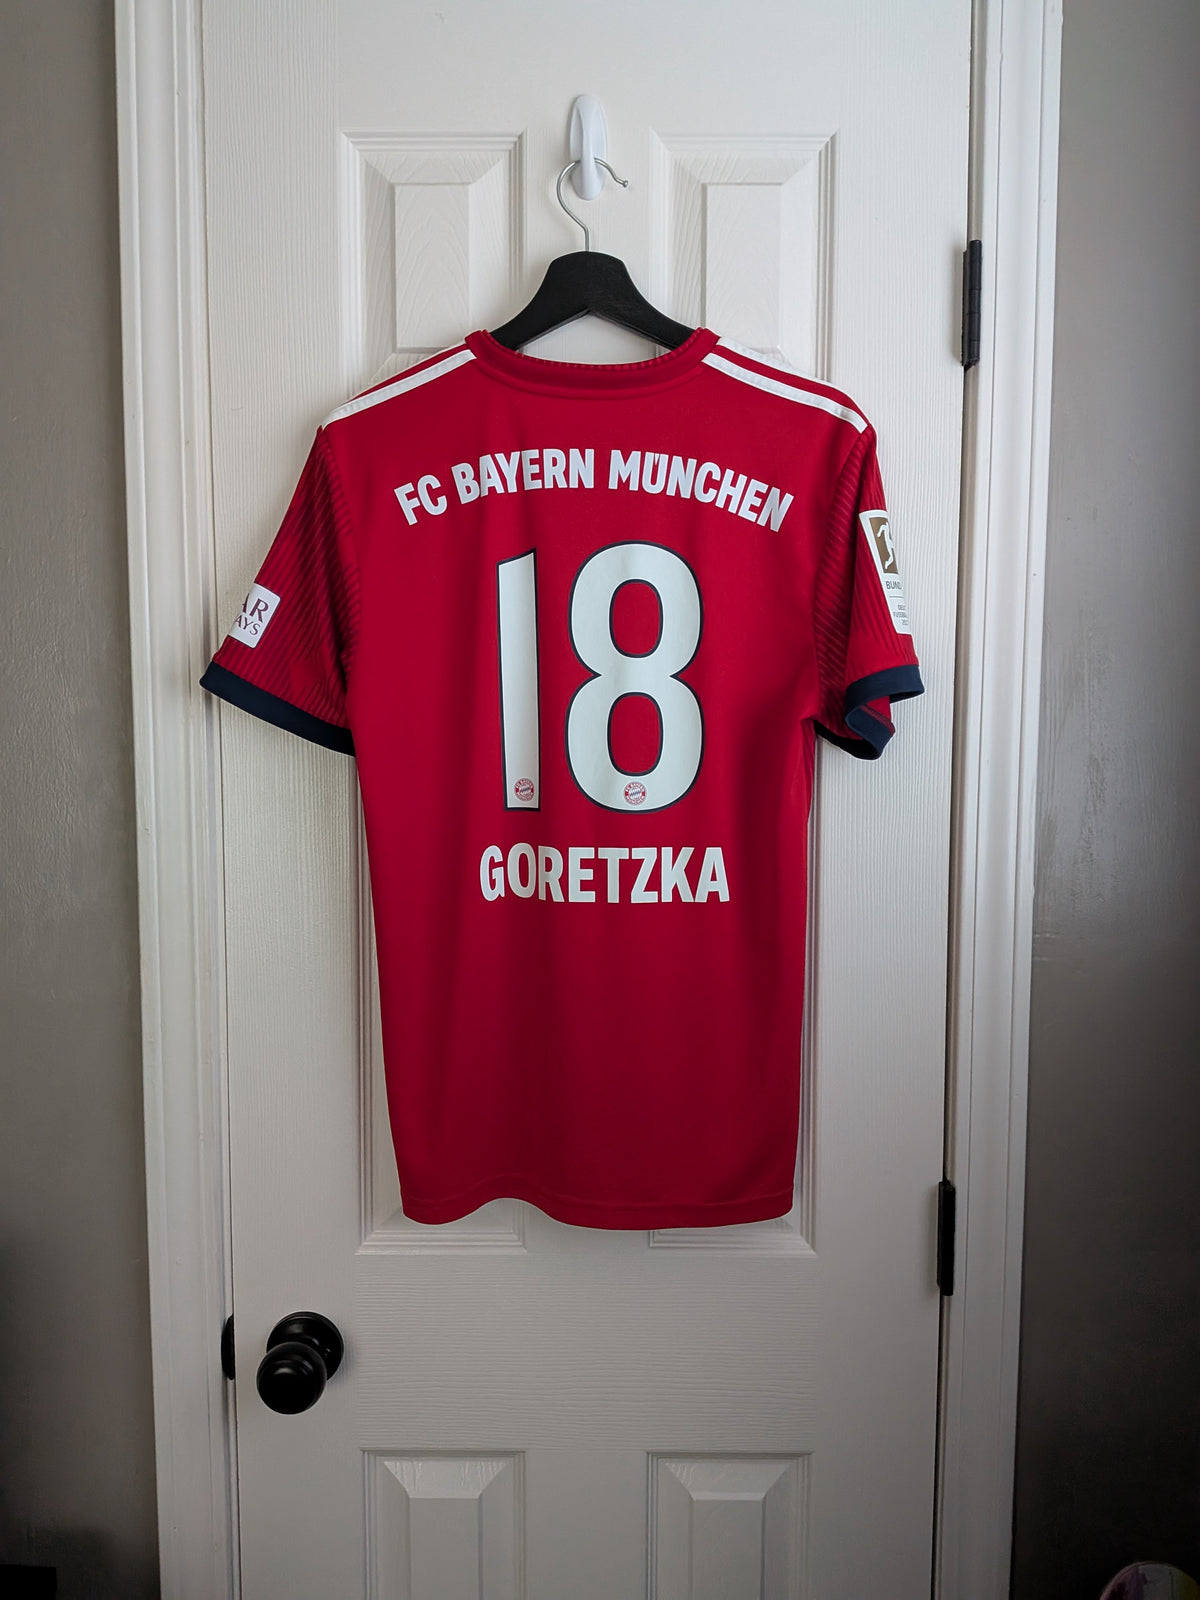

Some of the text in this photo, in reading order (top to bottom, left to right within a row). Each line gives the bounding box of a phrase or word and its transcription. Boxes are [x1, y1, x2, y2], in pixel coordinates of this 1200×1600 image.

[395, 448, 794, 532] FC BAYERN MÜNCHEN
[496, 540, 705, 812] 18
[480, 842, 730, 903] GORETZKA
